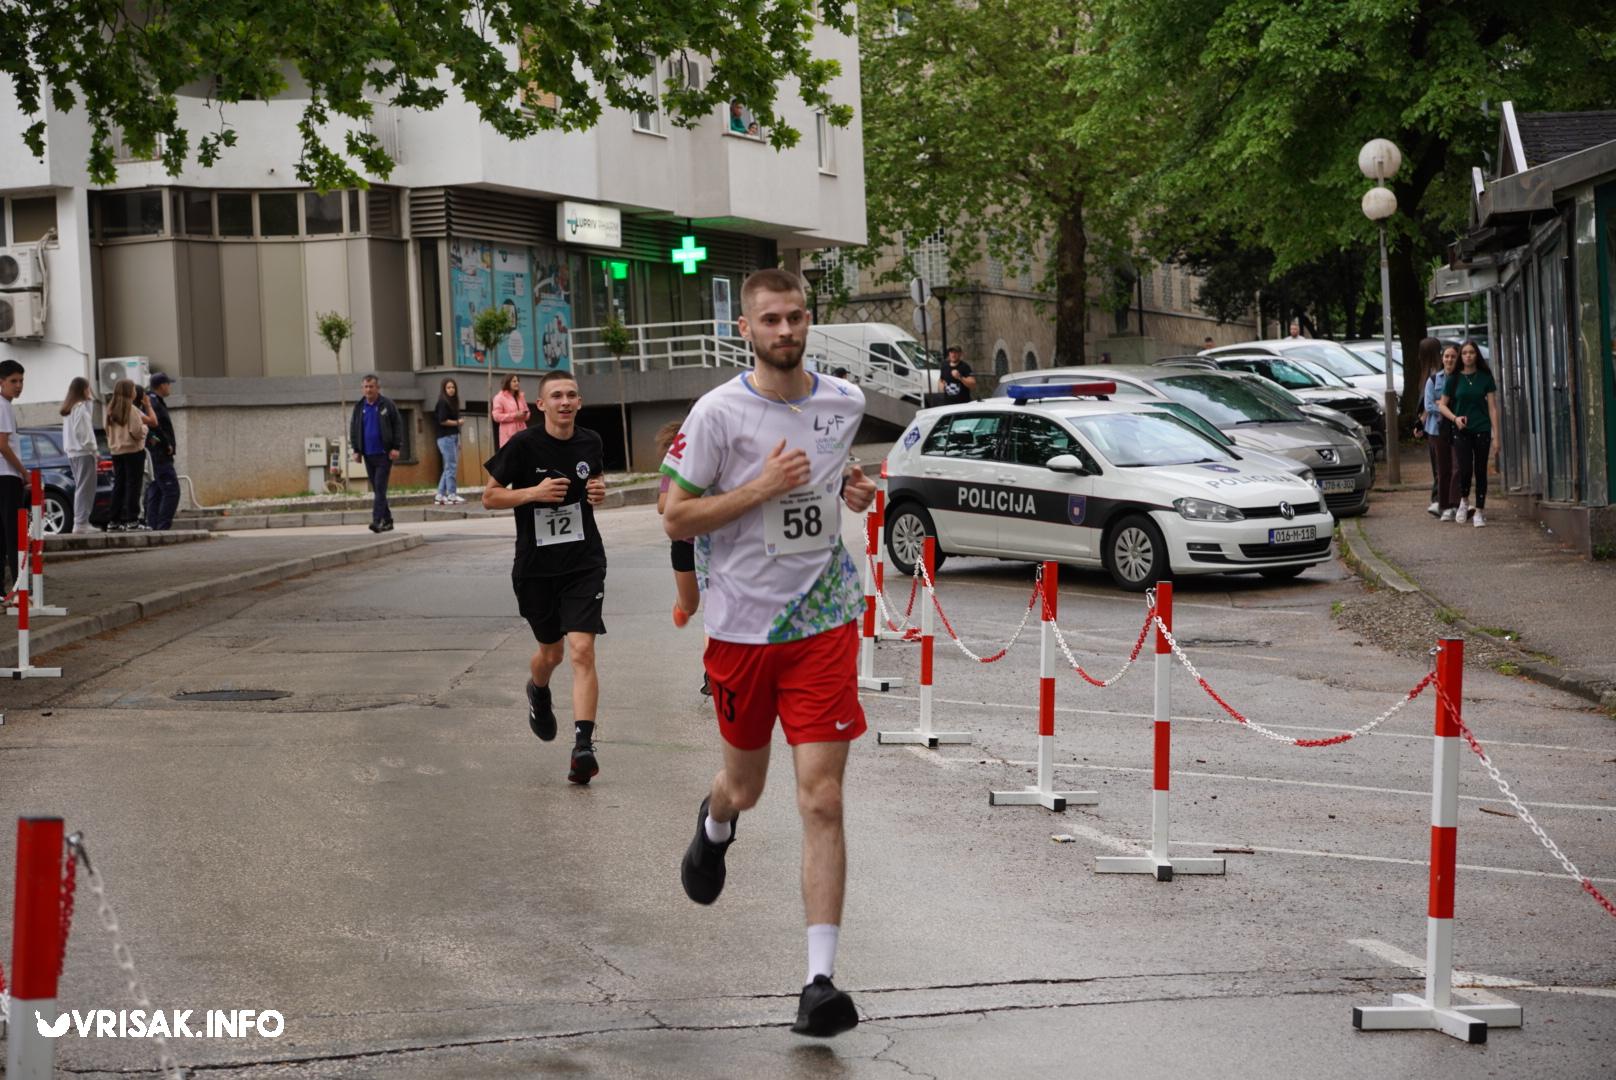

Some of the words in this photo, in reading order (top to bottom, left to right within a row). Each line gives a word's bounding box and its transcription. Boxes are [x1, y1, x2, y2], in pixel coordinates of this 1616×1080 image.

[958, 486, 1036, 514] POLICIJA
[546, 517, 572, 536] 12
[783, 505, 822, 540] 58
[1275, 527, 1315, 543] 016-M-118
